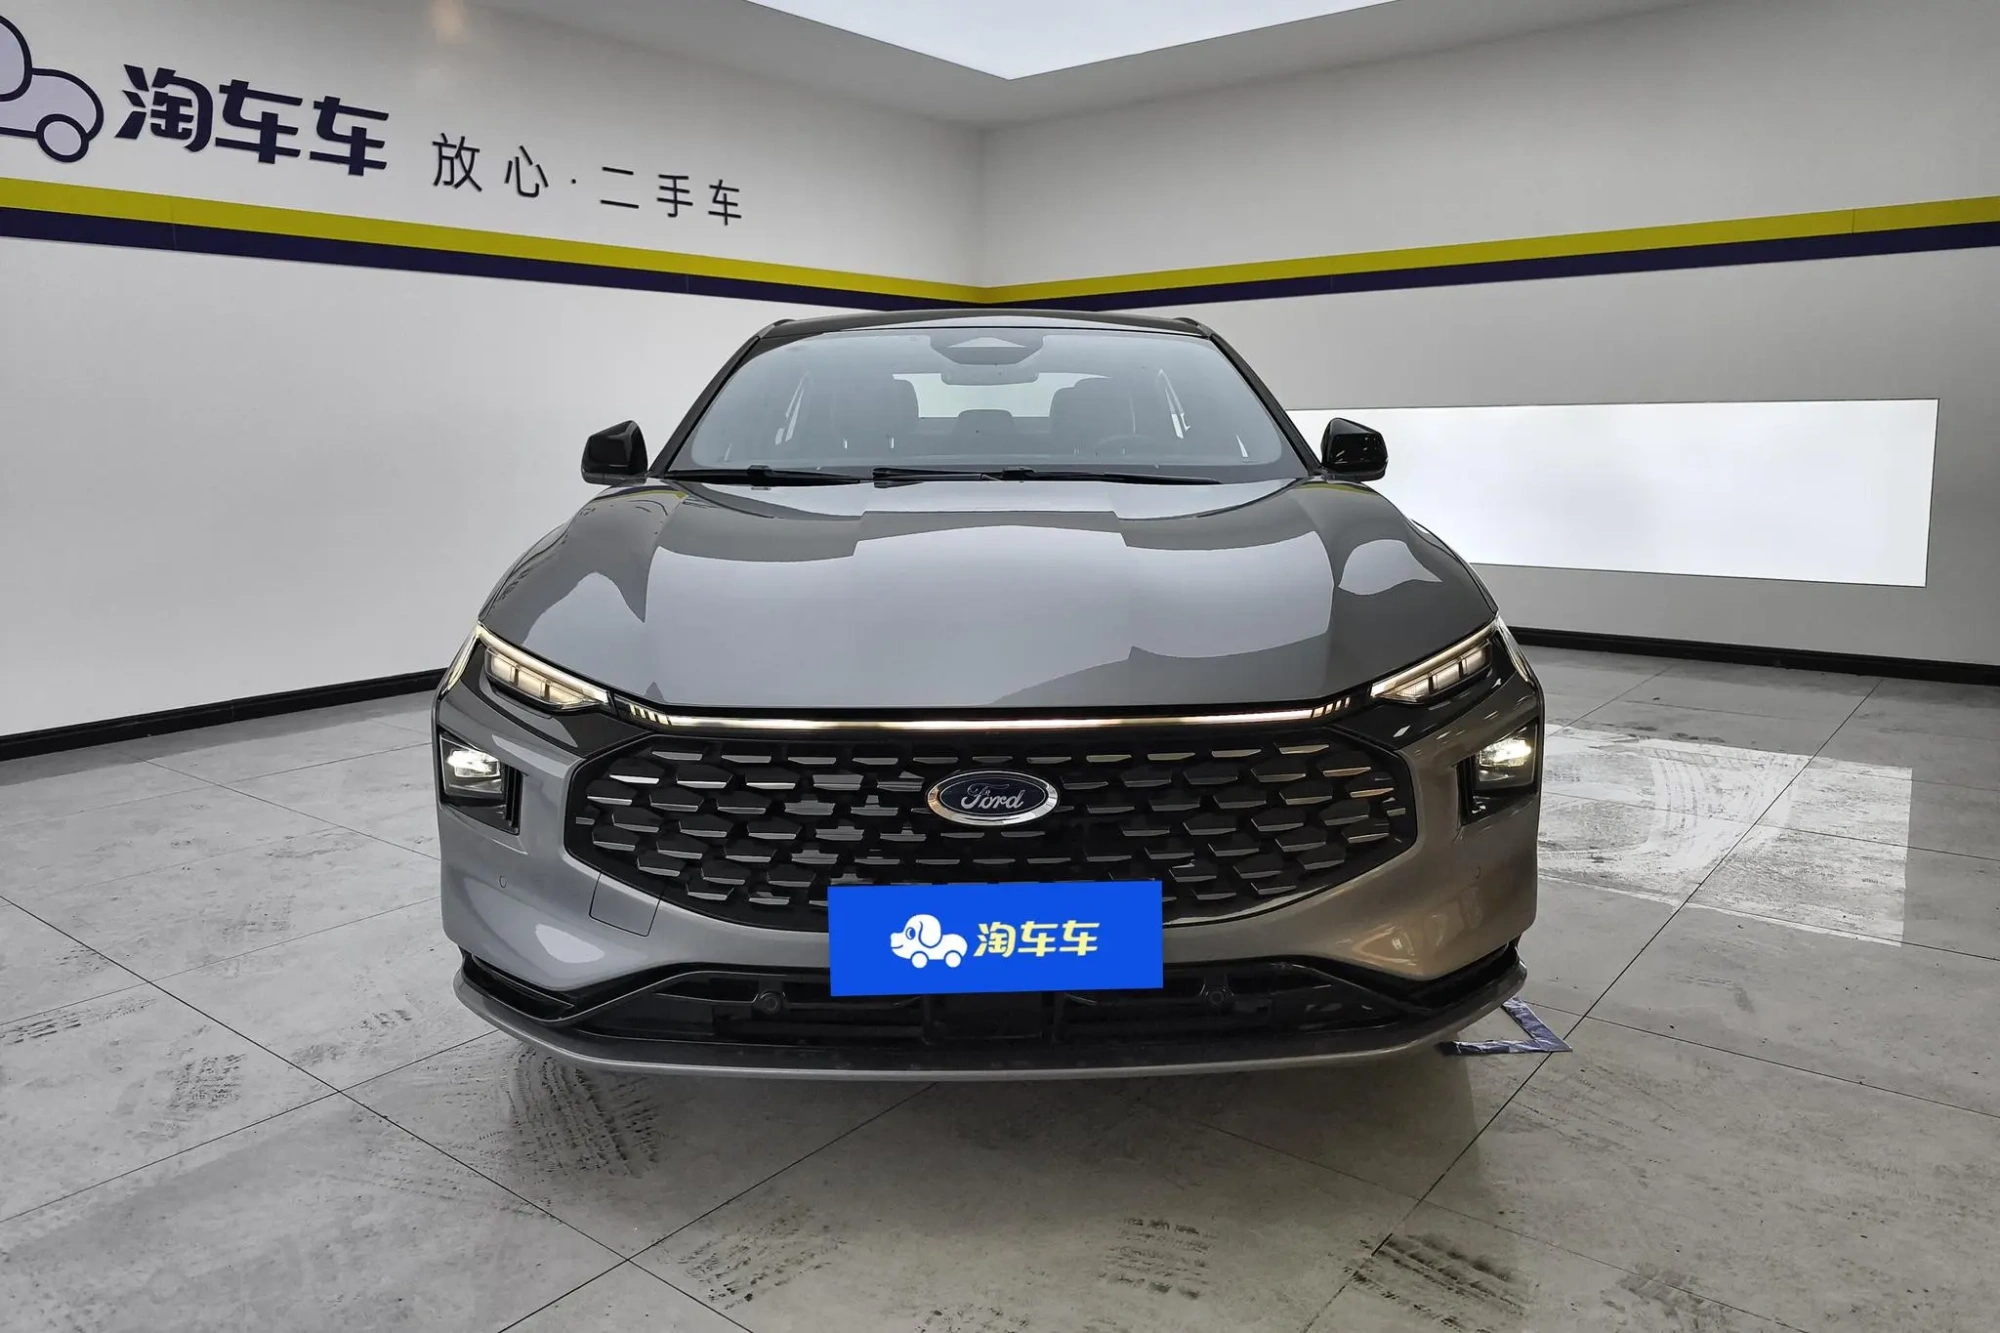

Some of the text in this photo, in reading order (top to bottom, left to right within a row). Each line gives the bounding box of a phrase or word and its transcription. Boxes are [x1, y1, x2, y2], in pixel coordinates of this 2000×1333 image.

[115, 63, 389, 177] 淘车车
[960, 782, 1025, 810] Ford
